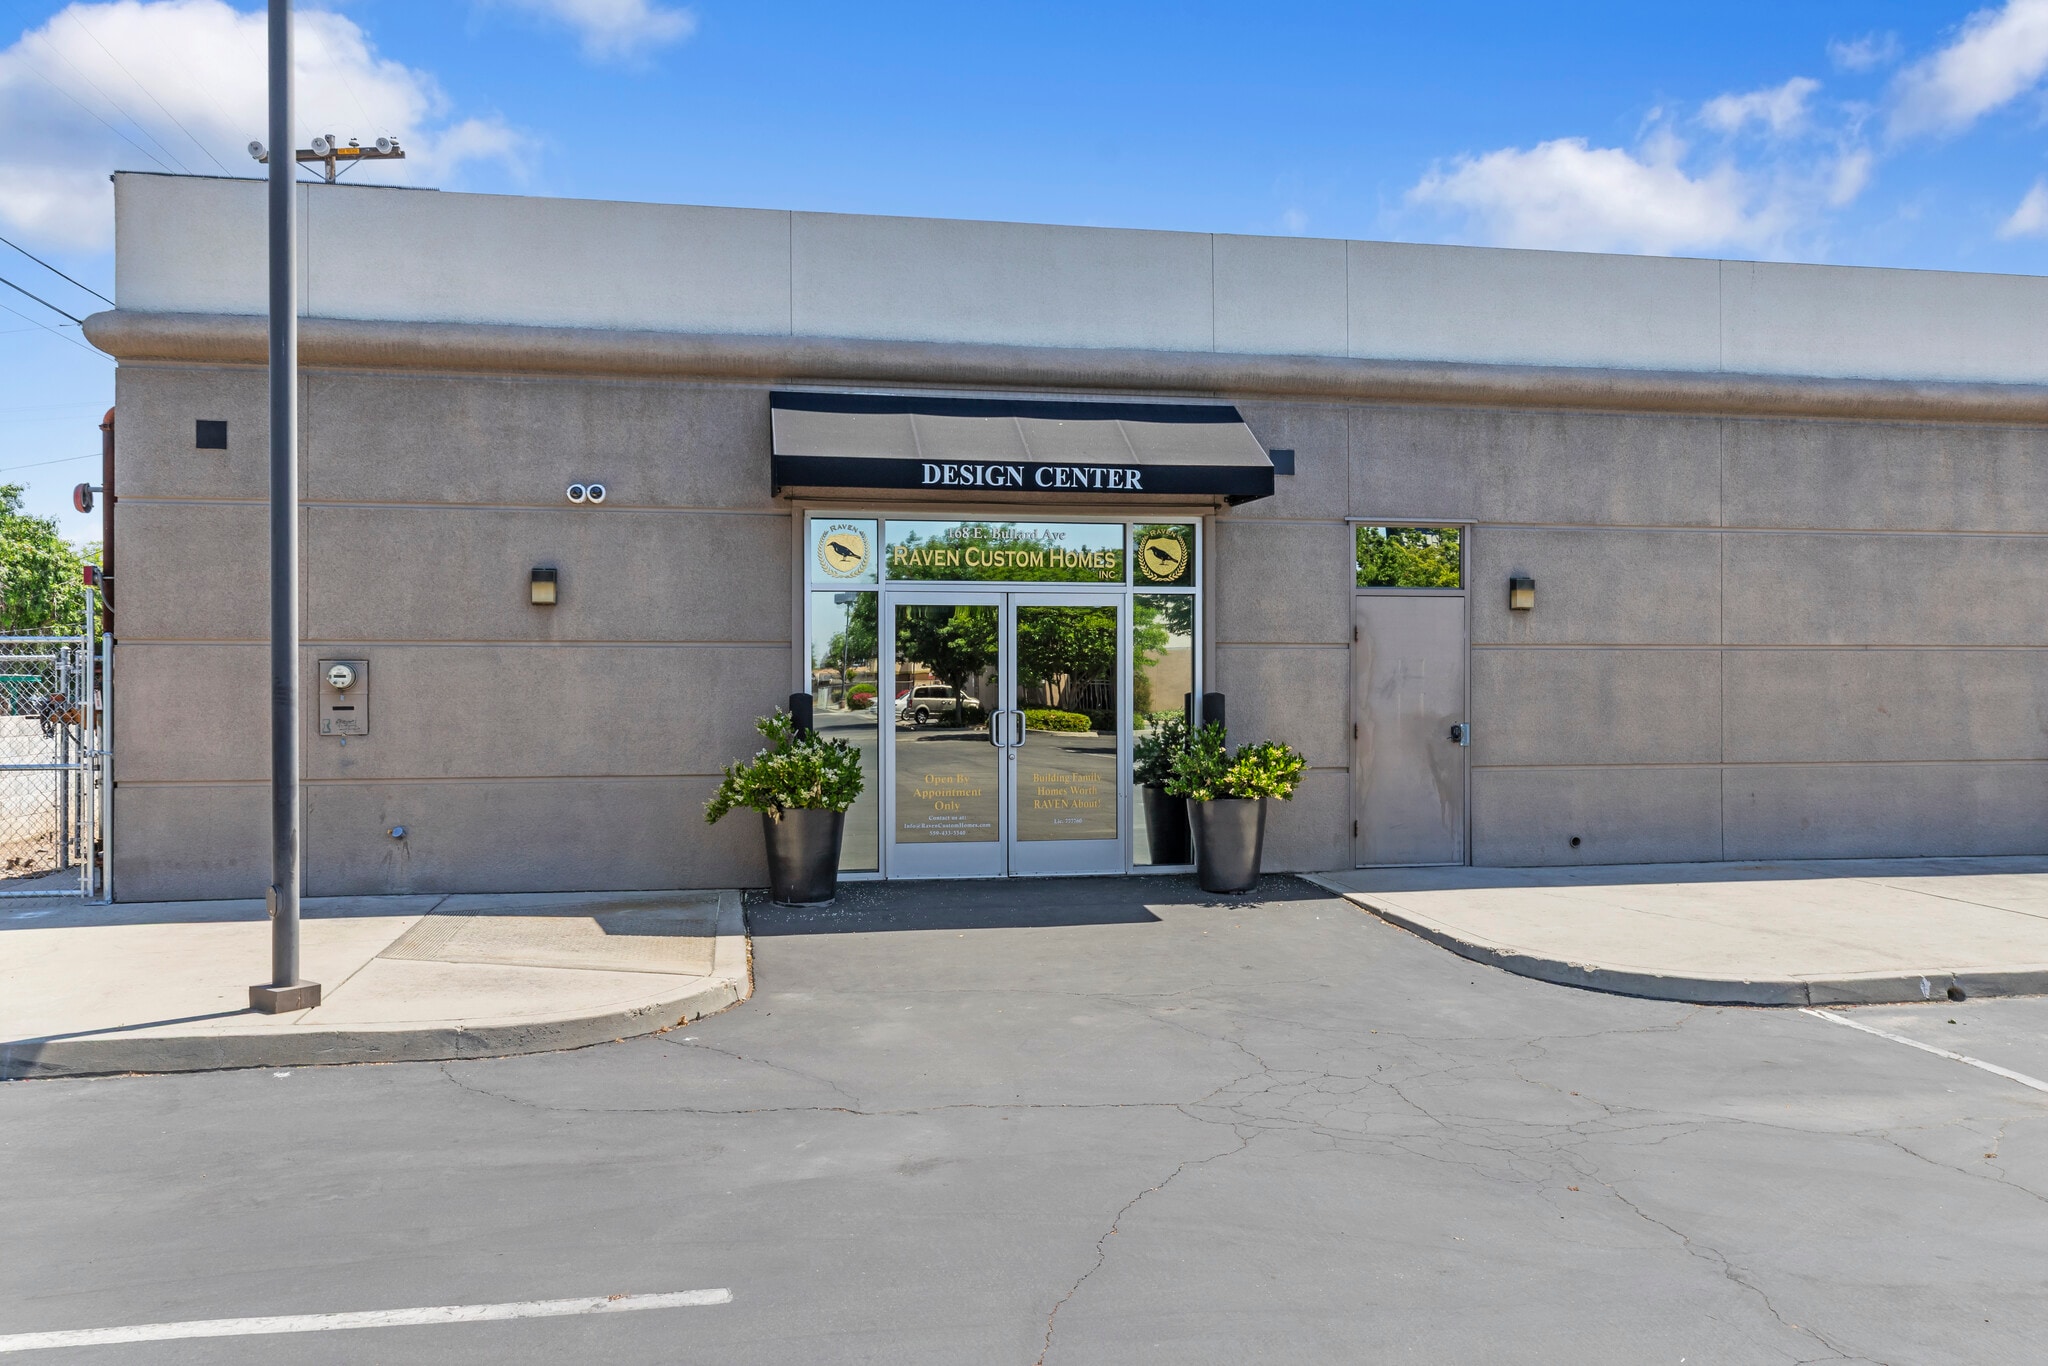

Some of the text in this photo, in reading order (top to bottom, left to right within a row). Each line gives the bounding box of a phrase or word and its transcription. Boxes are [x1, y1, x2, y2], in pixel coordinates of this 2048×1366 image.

[922, 463, 1144, 490] DESIGN CENTER
[829, 523, 859, 533] RAVEN
[948, 527, 1066, 541] 168 E. Bullard Ave
[1149, 528, 1178, 538] RAVEN
[893, 546, 1116, 569] RAVEN CUSTOM HOMES
[1098, 570, 1116, 580] INC
[925, 773, 970, 786] Open By
[1033, 772, 1102, 785] Building Family
[913, 788, 982, 800] Appointment
[1037, 785, 1098, 796] Homes Worth
[934, 800, 960, 812] Only
[1034, 799, 1069, 809] RAVEN
